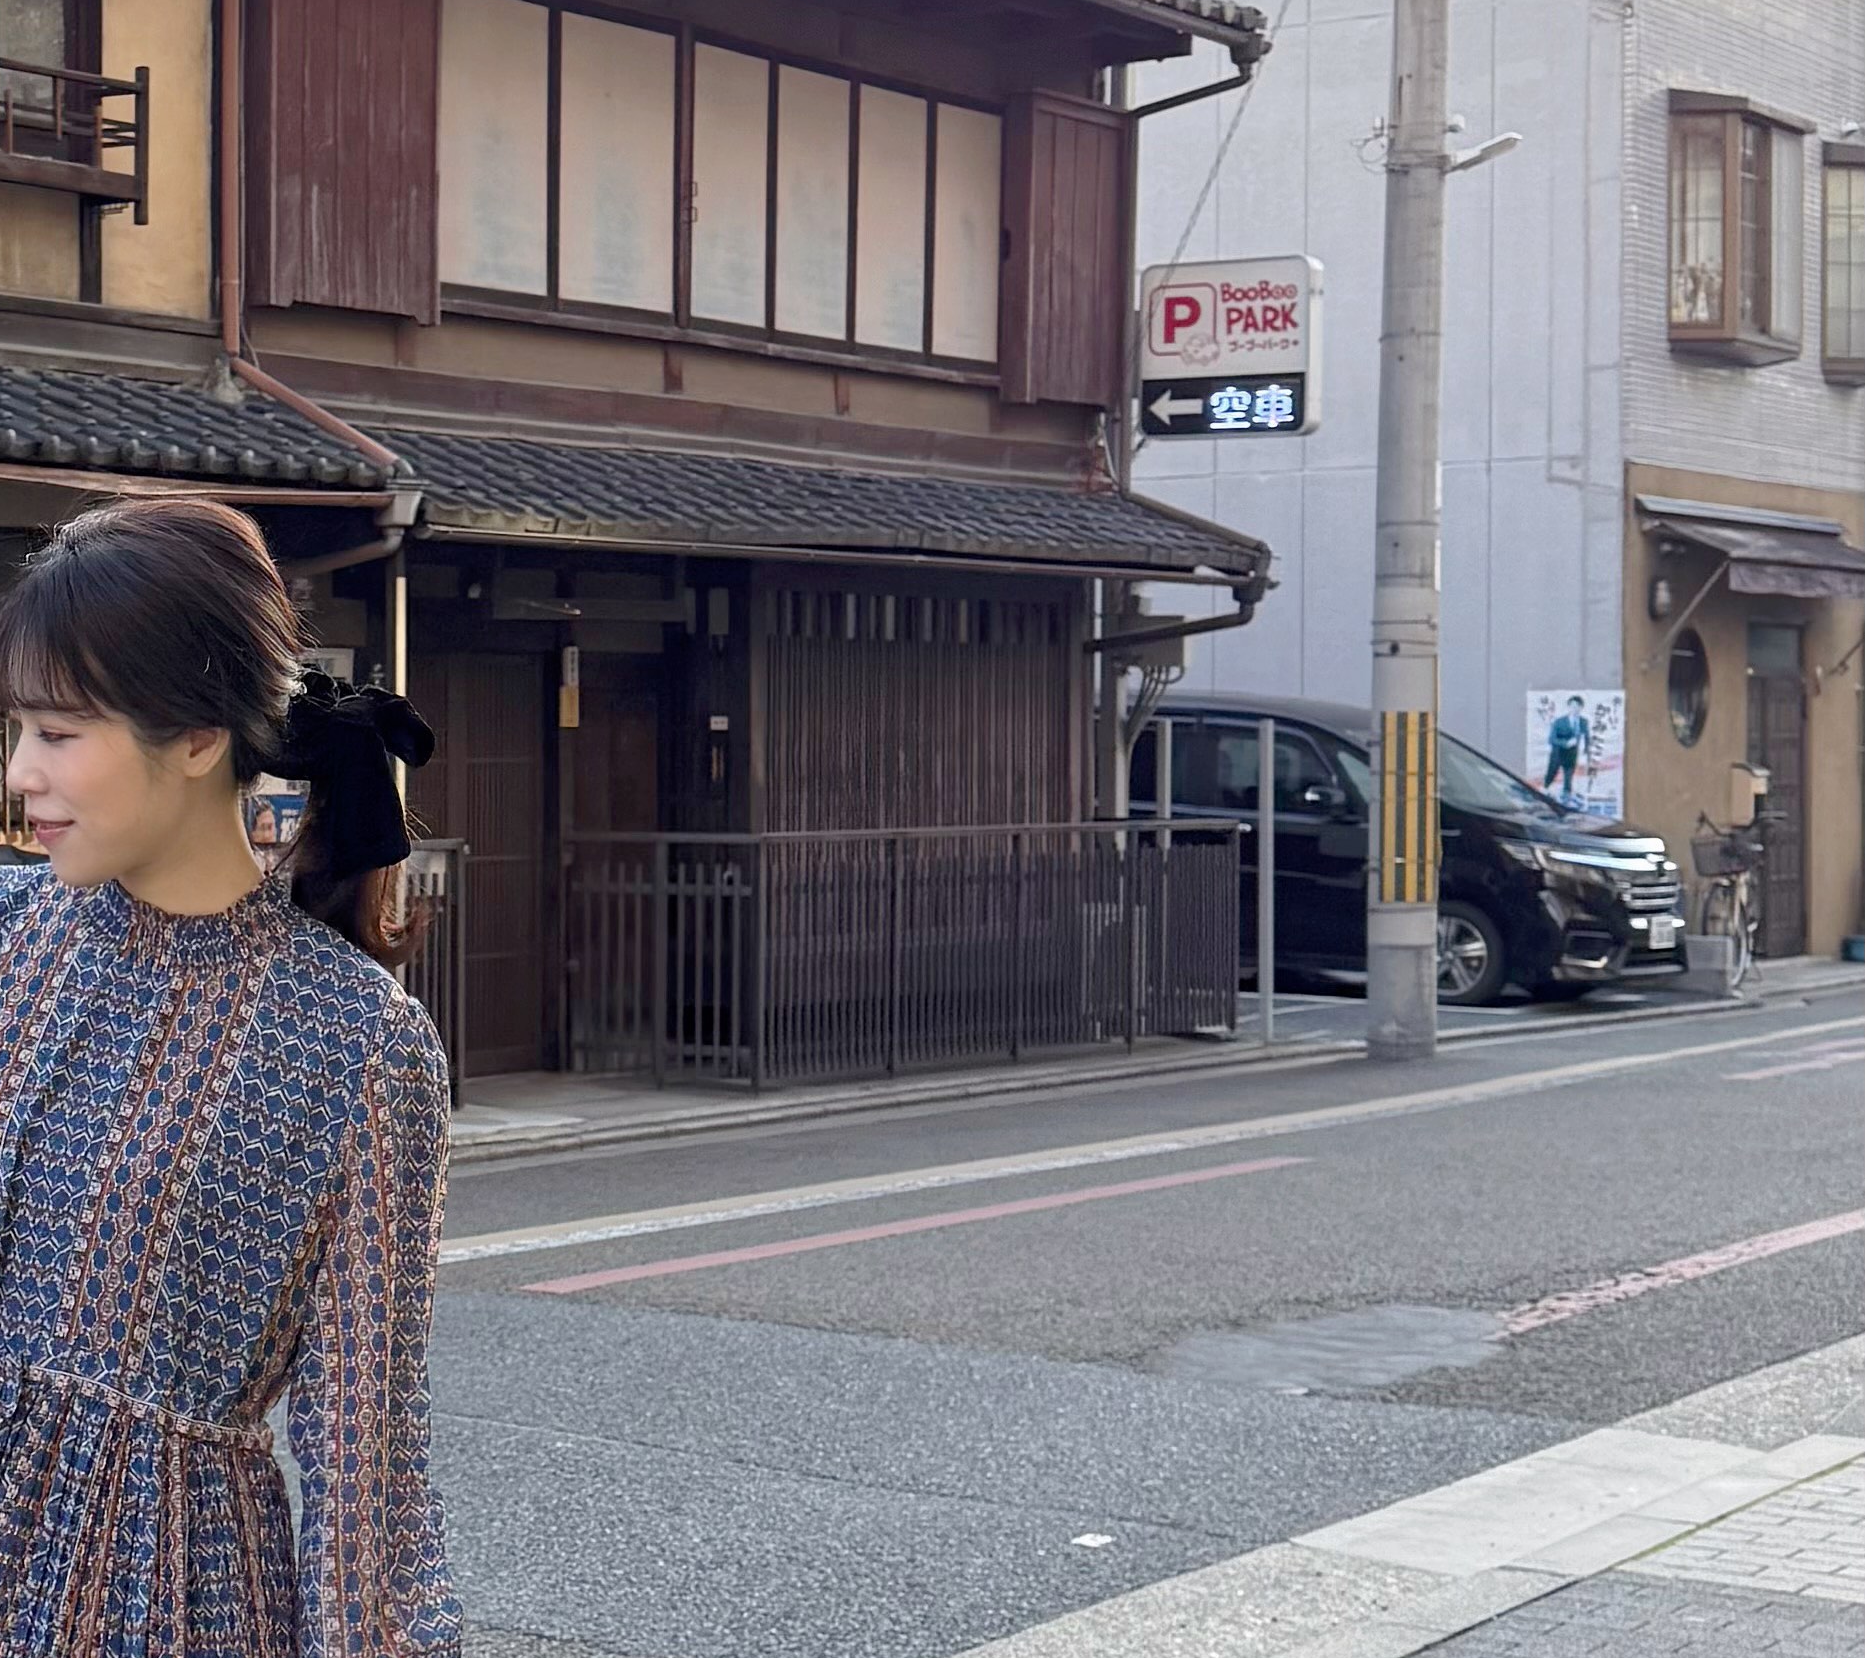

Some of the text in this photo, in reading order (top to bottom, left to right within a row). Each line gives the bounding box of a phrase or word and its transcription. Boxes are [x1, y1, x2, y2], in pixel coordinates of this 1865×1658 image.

[1163, 296, 1202, 344] P
[1226, 302, 1299, 335] PARK
[1209, 384, 1295, 430] 空車
